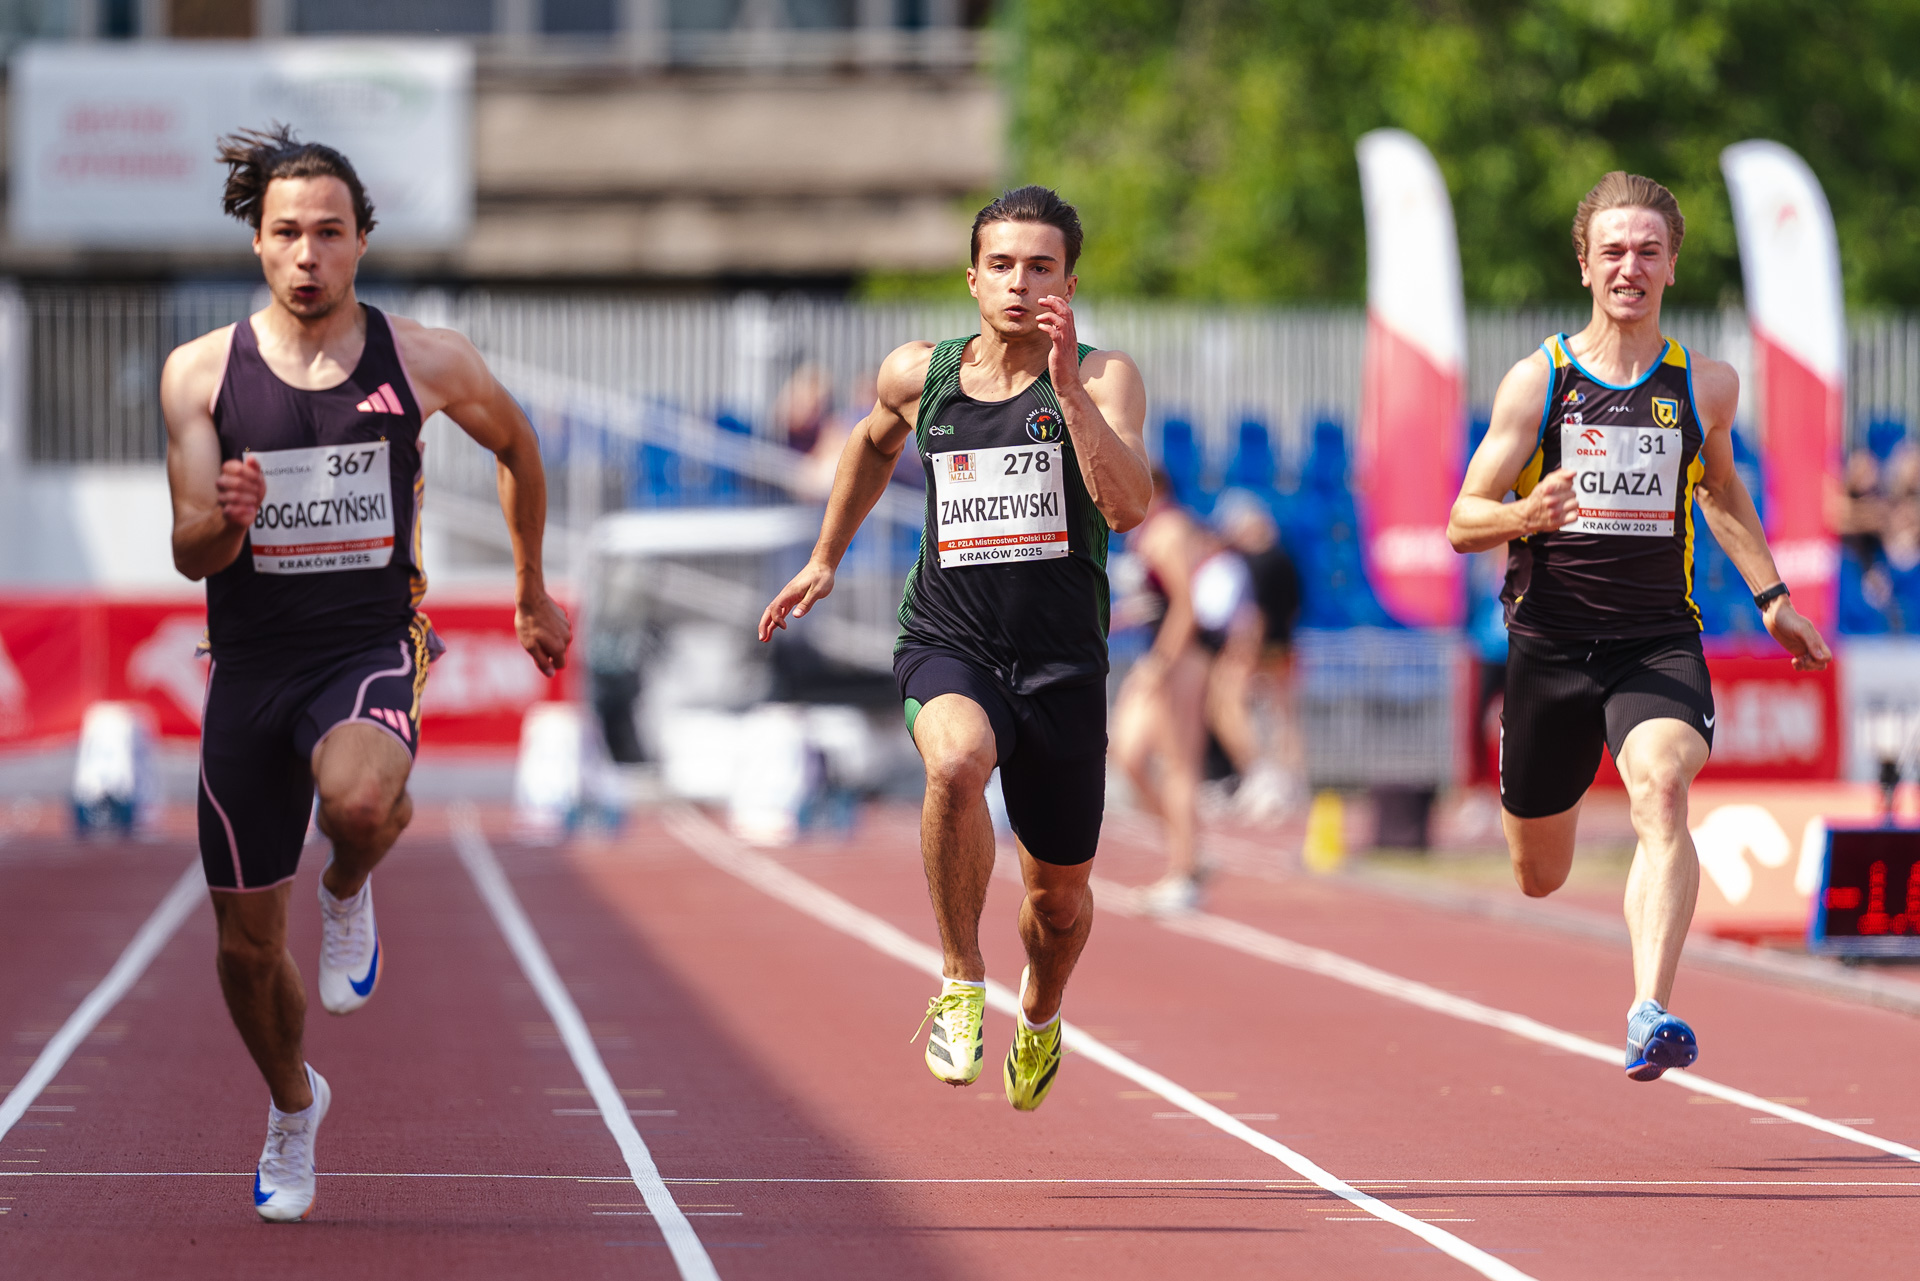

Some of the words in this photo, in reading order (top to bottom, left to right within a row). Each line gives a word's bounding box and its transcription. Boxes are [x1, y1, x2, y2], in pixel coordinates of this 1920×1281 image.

[1026, 408, 1040, 422] AML
[928, 424, 954, 436] esa
[1576, 448, 1607, 457] ORLEN
[1638, 434, 1666, 455] 31
[327, 450, 376, 477] 367
[1003, 451, 1050, 475] 278
[950, 472, 974, 481] MZLA
[1580, 471, 1662, 496] GLAZA
[254, 492, 386, 529] BOGACZYŃSKI
[941, 491, 1059, 526] ZAKRZEWSKI
[1582, 509, 1597, 517] PZLA
[1598, 510, 1638, 518] Mistrzostwa
[1639, 511, 1657, 519] Polski
[1582, 520, 1631, 532] KRAKÓW
[1633, 523, 1658, 532] 2025
[947, 540, 957, 549] 42.
[958, 538, 974, 548] PZLA
[975, 535, 1019, 547] Mistrzostwa
[1019, 534, 1041, 543] Polski
[1042, 533, 1056, 542] U23
[278, 555, 336, 569] KRAKÓW
[340, 553, 371, 565] 2025
[960, 547, 1012, 562] KRAKÓW
[1014, 546, 1043, 559] 2025
